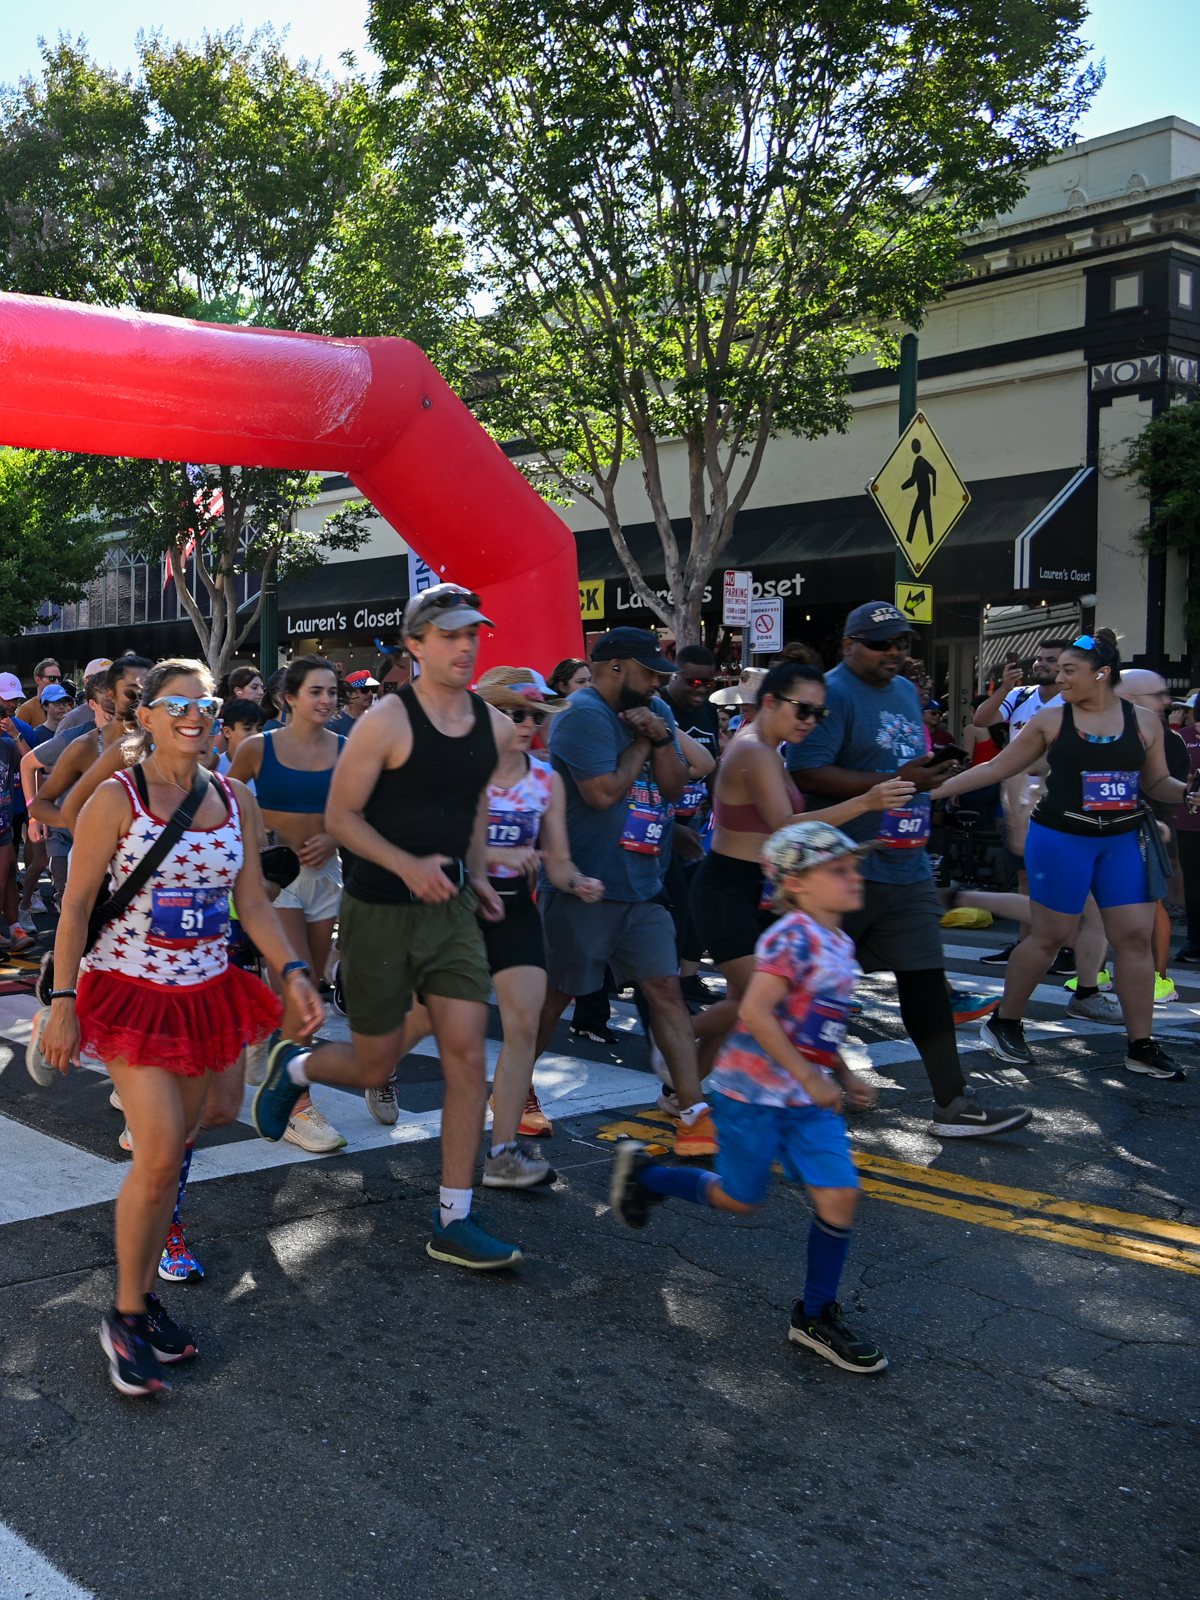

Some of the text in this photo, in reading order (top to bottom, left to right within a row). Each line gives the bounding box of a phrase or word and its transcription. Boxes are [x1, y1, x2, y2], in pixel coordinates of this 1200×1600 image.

[725, 574, 734, 584] NO
[1039, 567, 1090, 581] Lauren's Closet
[725, 588, 747, 598] PARKING
[287, 607, 403, 634] Lauren's Closet
[1100, 783, 1126, 796] 316
[898, 818, 922, 833] 947
[181, 908, 204, 930] 51
